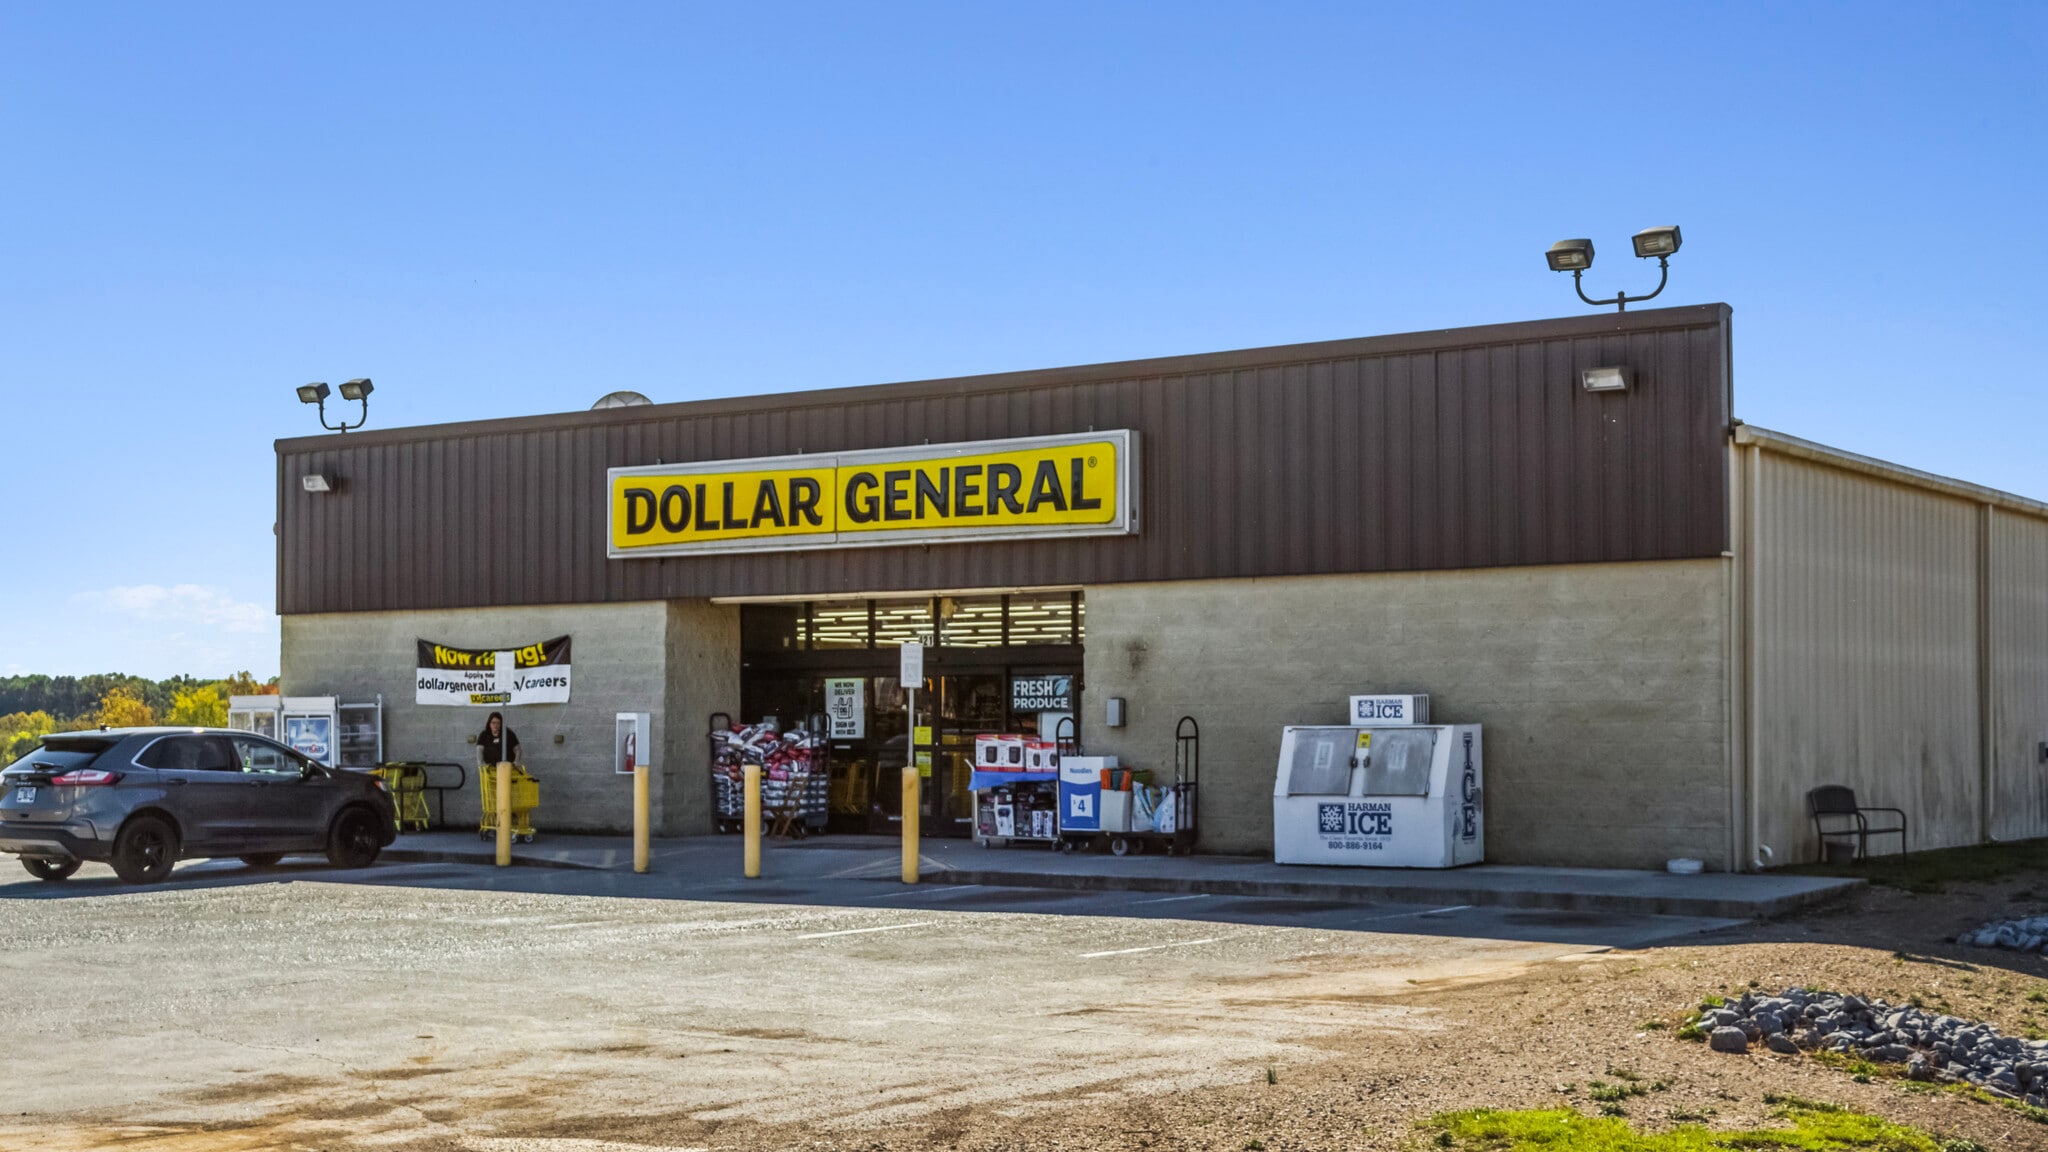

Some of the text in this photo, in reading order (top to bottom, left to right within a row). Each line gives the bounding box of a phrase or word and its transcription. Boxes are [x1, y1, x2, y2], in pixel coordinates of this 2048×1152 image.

[624, 456, 1102, 535] DOLLAR GENERAL
[1013, 680, 1053, 697] FRESH
[1013, 697, 1068, 709] PRODUCE
[1375, 705, 1404, 718] ICE
[1348, 803, 1391, 812] HARMAN
[1347, 811, 1393, 835] ICE
